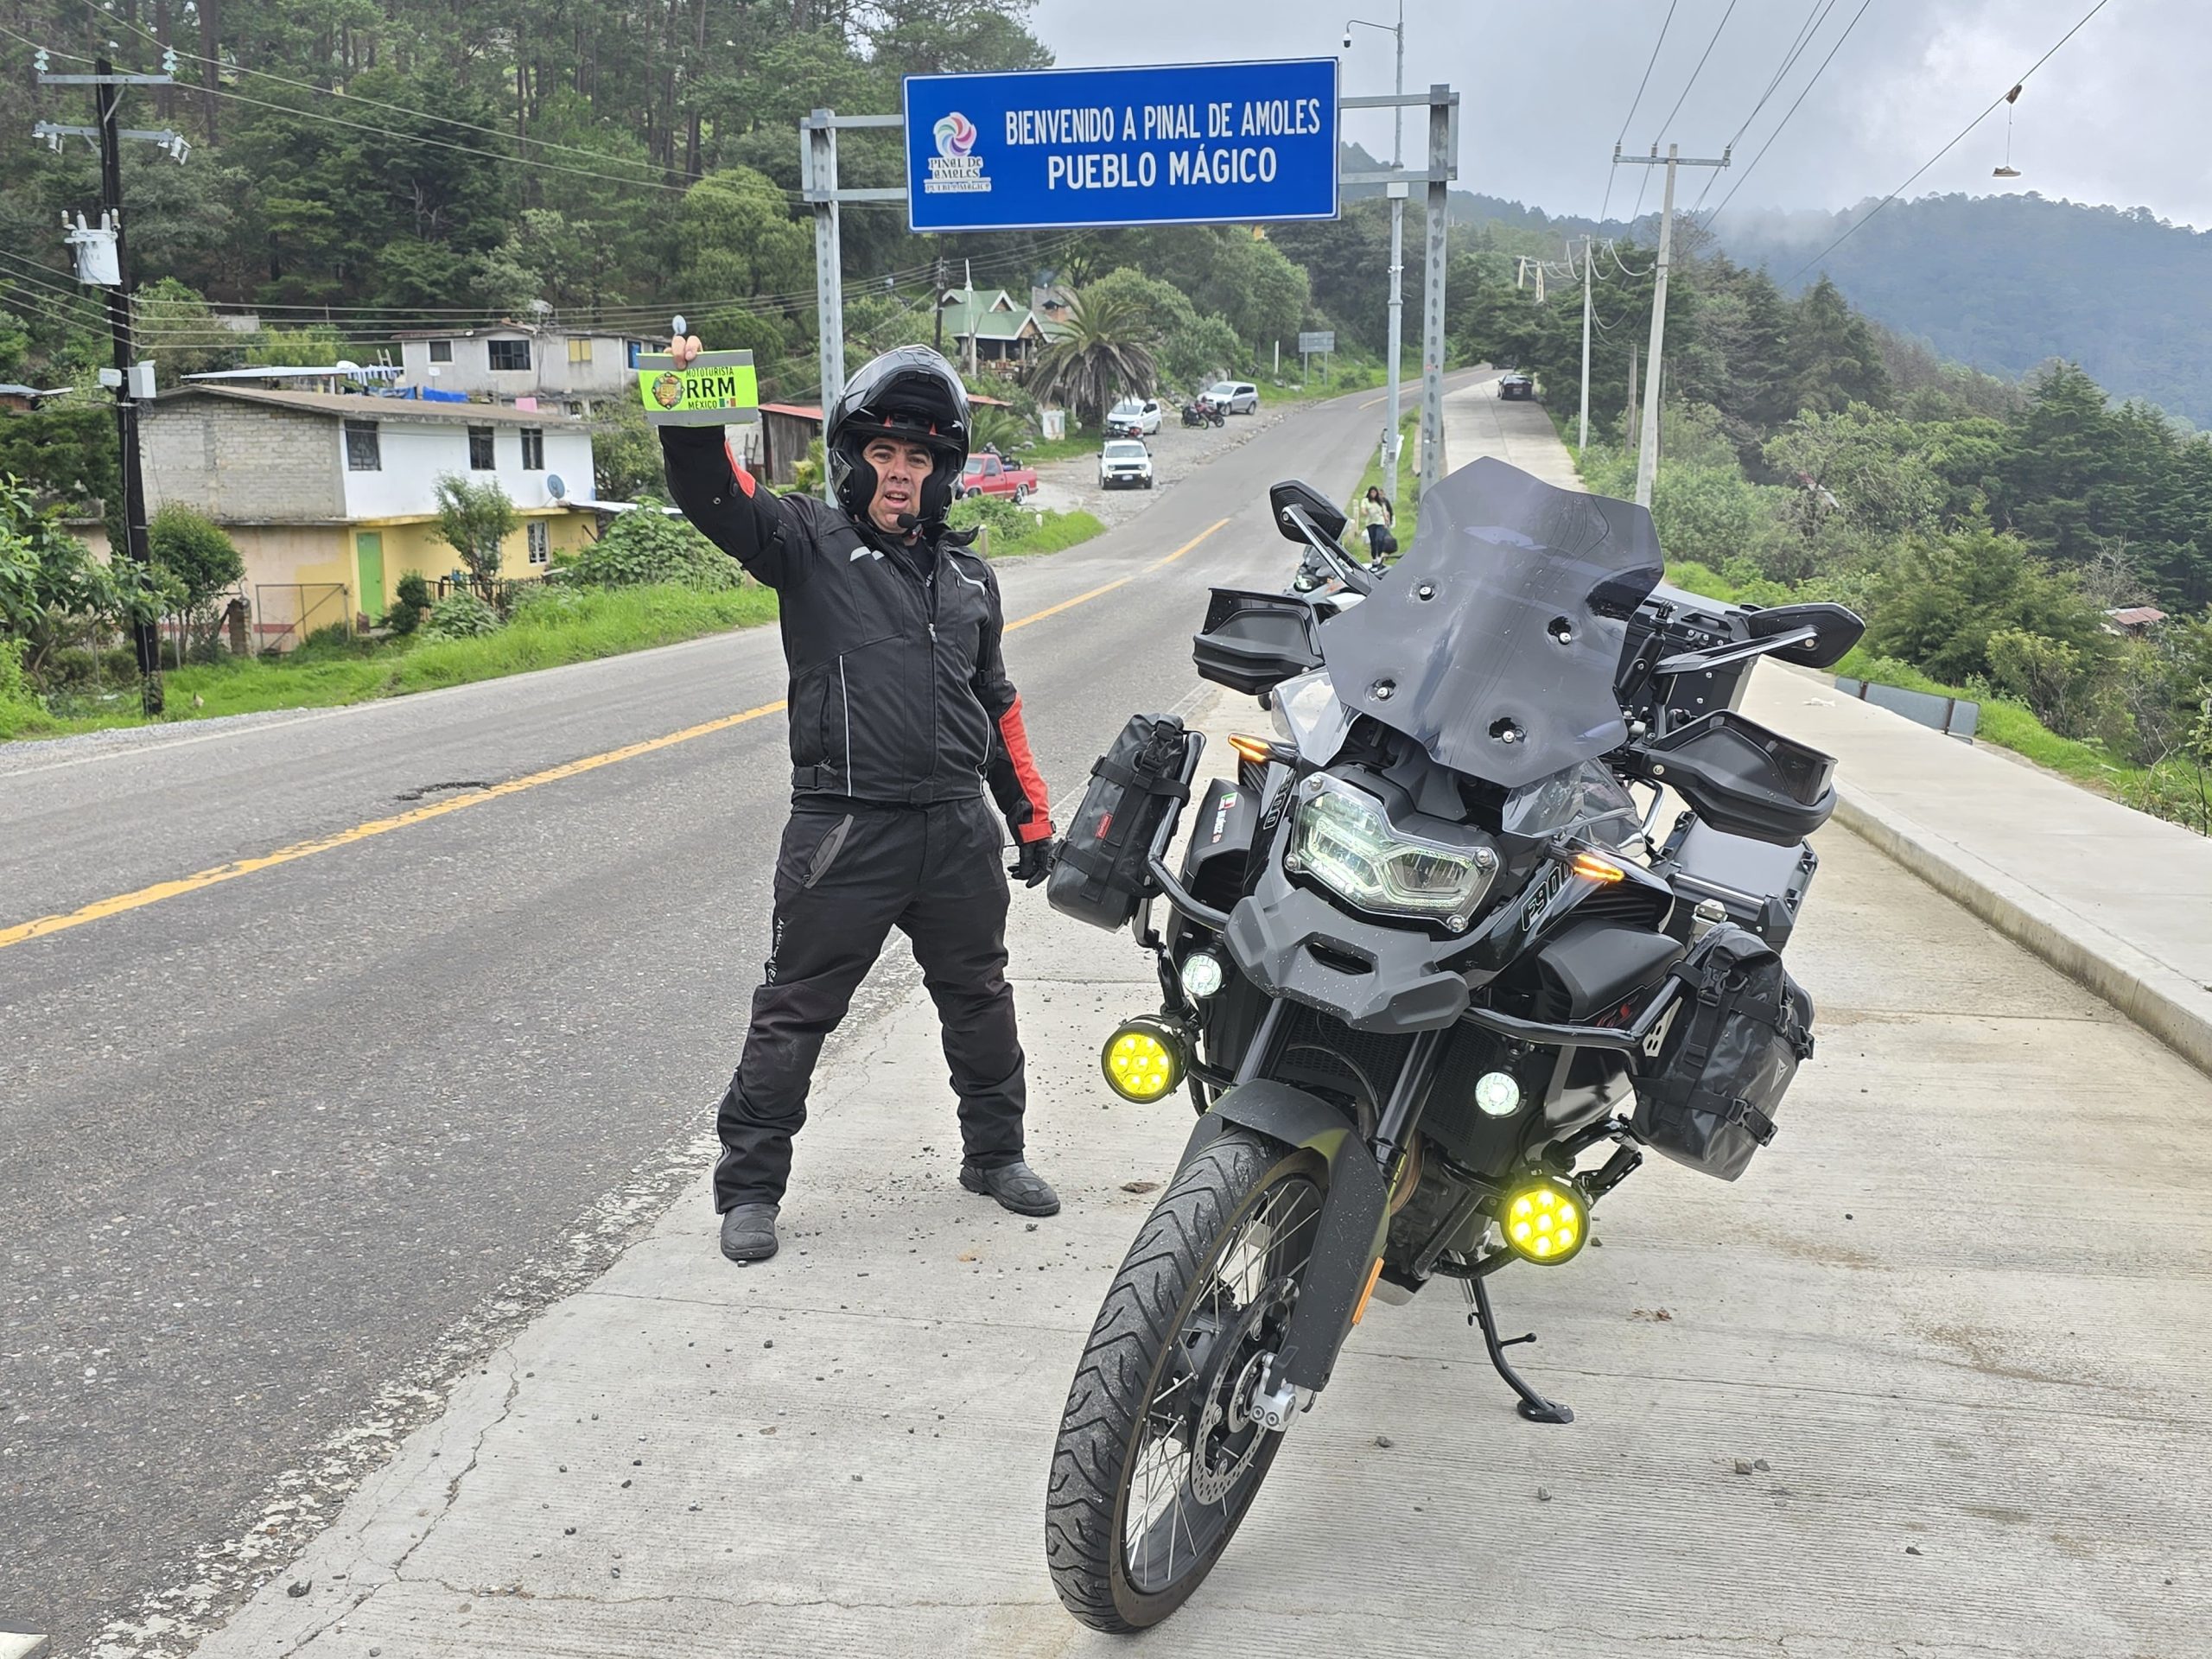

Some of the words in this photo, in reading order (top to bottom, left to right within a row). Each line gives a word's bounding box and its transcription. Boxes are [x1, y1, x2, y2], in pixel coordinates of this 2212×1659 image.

[1006, 106, 1115, 145] BIENVENIDO
[1122, 105, 1137, 141] A
[1144, 104, 1201, 141] PINAL
[1208, 102, 1233, 138] DE
[1241, 98, 1320, 137] AMOLES
[1048, 151, 1157, 190] PUEBLO
[1169, 143, 1277, 186] MÁGICO
[686, 366, 734, 378] MOTOTURISTA
[687, 377, 735, 398] RRM
